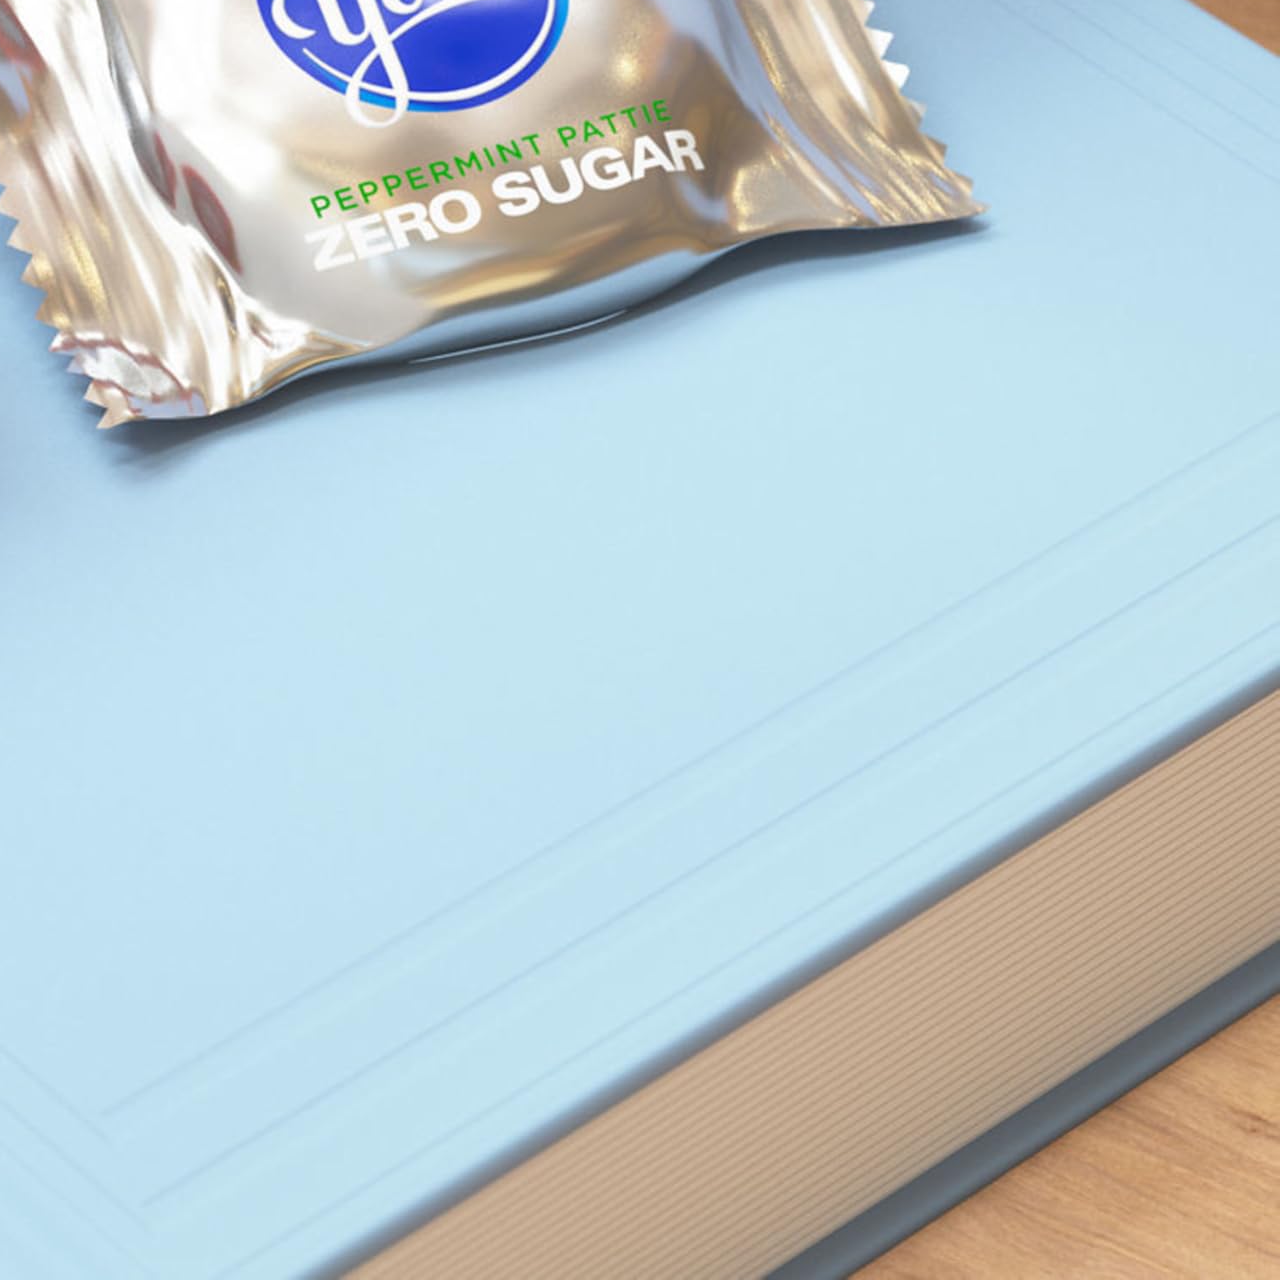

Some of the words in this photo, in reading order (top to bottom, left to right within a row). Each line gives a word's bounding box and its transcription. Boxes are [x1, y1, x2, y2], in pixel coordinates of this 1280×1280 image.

[305, 189, 483, 271] ZERO
[491, 129, 705, 218] SUGAR
[311, 133, 540, 219] PEPPERMINT
[557, 99, 673, 149] PATTIE
